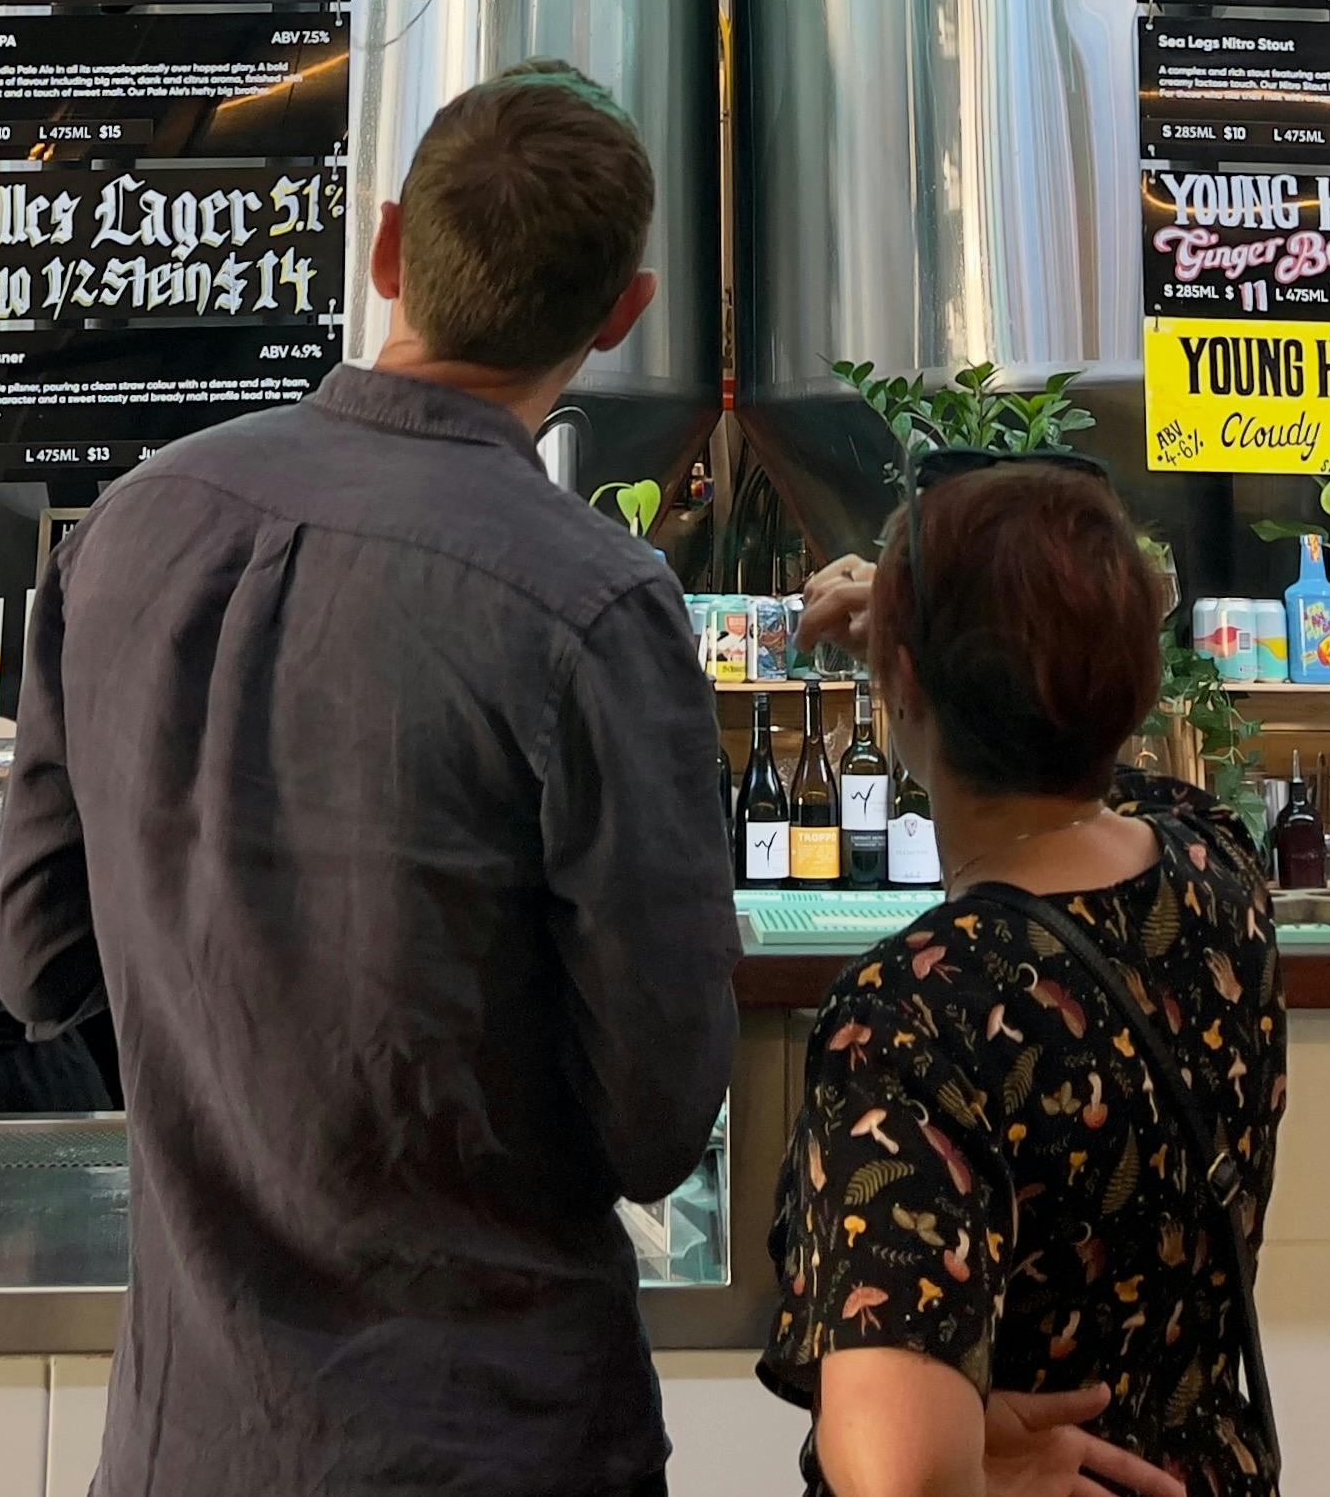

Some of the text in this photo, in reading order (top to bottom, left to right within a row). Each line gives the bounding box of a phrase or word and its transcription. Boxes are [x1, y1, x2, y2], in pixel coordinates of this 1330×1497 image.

[271, 30, 330, 43] ABV 7.5%
[1158, 35, 1295, 52] Sea Legs Nitro Stout
[39, 127, 47, 139] L
[50, 126, 91, 139] 475ML
[99, 124, 121, 140] $15
[1162, 125, 1171, 138] S
[1174, 125, 1216, 140] 285ML
[1223, 125, 1246, 141] $10
[1273, 128, 1282, 141] L
[1284, 128, 1325, 143] 475ML
[1159, 173, 1299, 231] YOUNG
[91, 173, 264, 258] Lager
[1153, 227, 1284, 282] Ginger
[1164, 284, 1173, 297] S
[1175, 284, 1219, 299] 285ML
[1275, 287, 1284, 301] L
[1286, 287, 1328, 303] 475ML
[259, 344, 322, 360] ABV 4.9%
[1179, 335, 1305, 397] YOUNG
[1221, 411, 1319, 462] Cloudy
